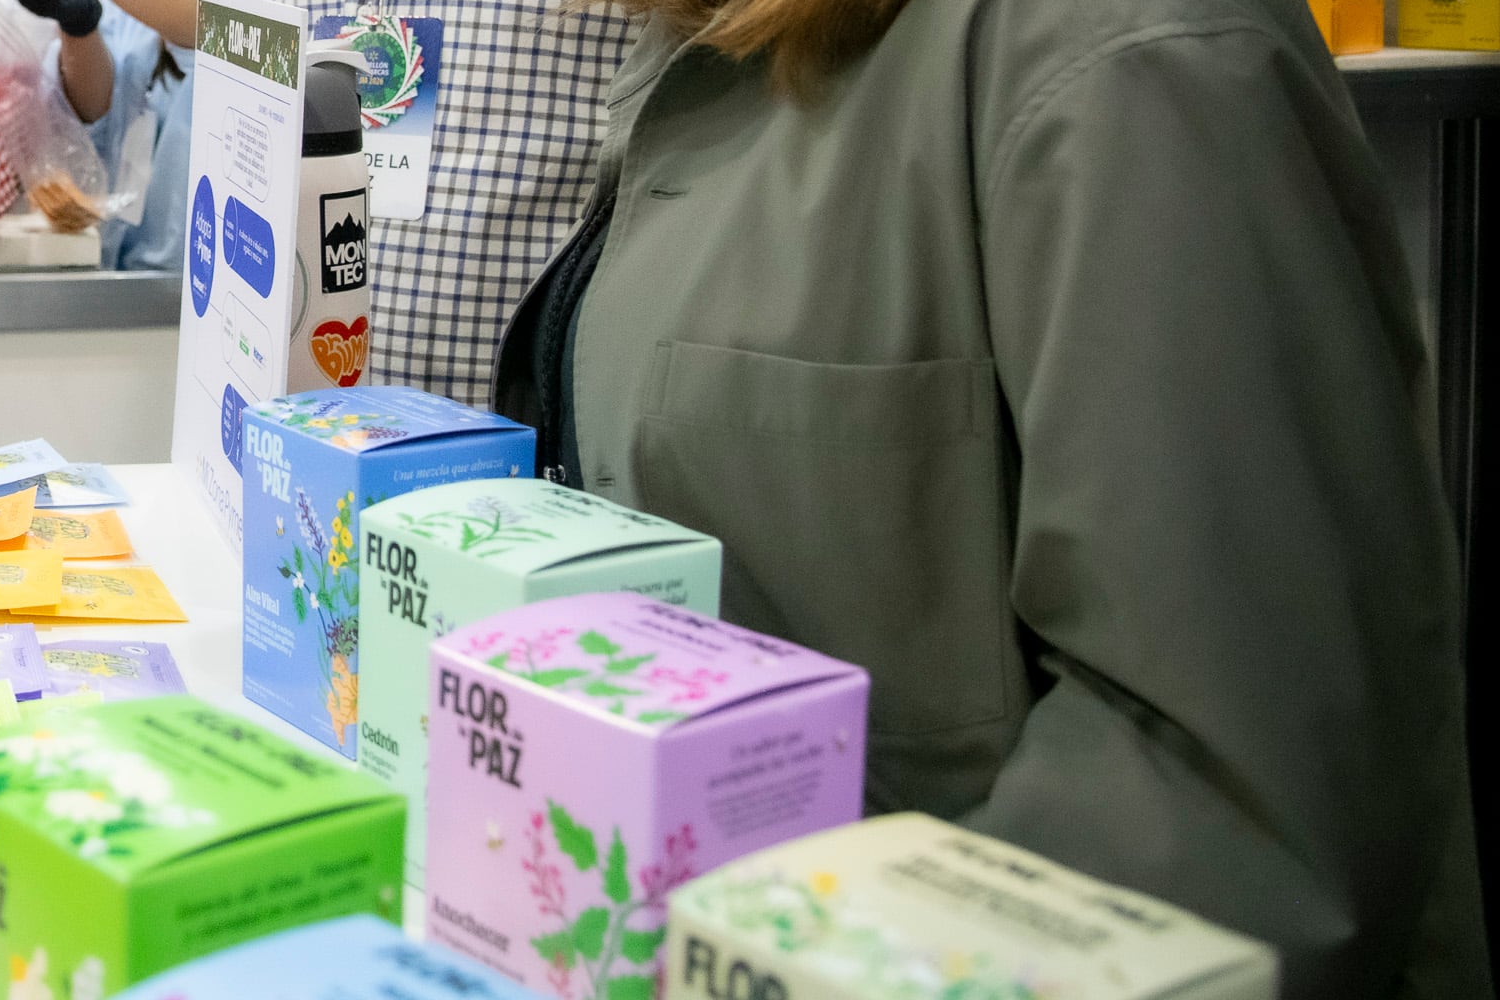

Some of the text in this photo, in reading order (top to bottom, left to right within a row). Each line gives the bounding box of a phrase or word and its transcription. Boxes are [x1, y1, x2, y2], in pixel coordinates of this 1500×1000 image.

[228, 18, 244, 57] FLOR
[248, 25, 261, 63] PAZ
[389, 154, 410, 169] LA
[325, 238, 365, 266] MON
[330, 261, 364, 286] TEC
[246, 423, 284, 468] FLOR
[262, 462, 291, 504] PAZ
[416, 463, 448, 479] mezcla
[451, 464, 468, 478] que
[367, 531, 417, 585] FLOR
[388, 580, 427, 629] PAZ
[440, 668, 507, 734] FLOR
[362, 721, 399, 757] Cedrón
[469, 729, 521, 789] PAZ
